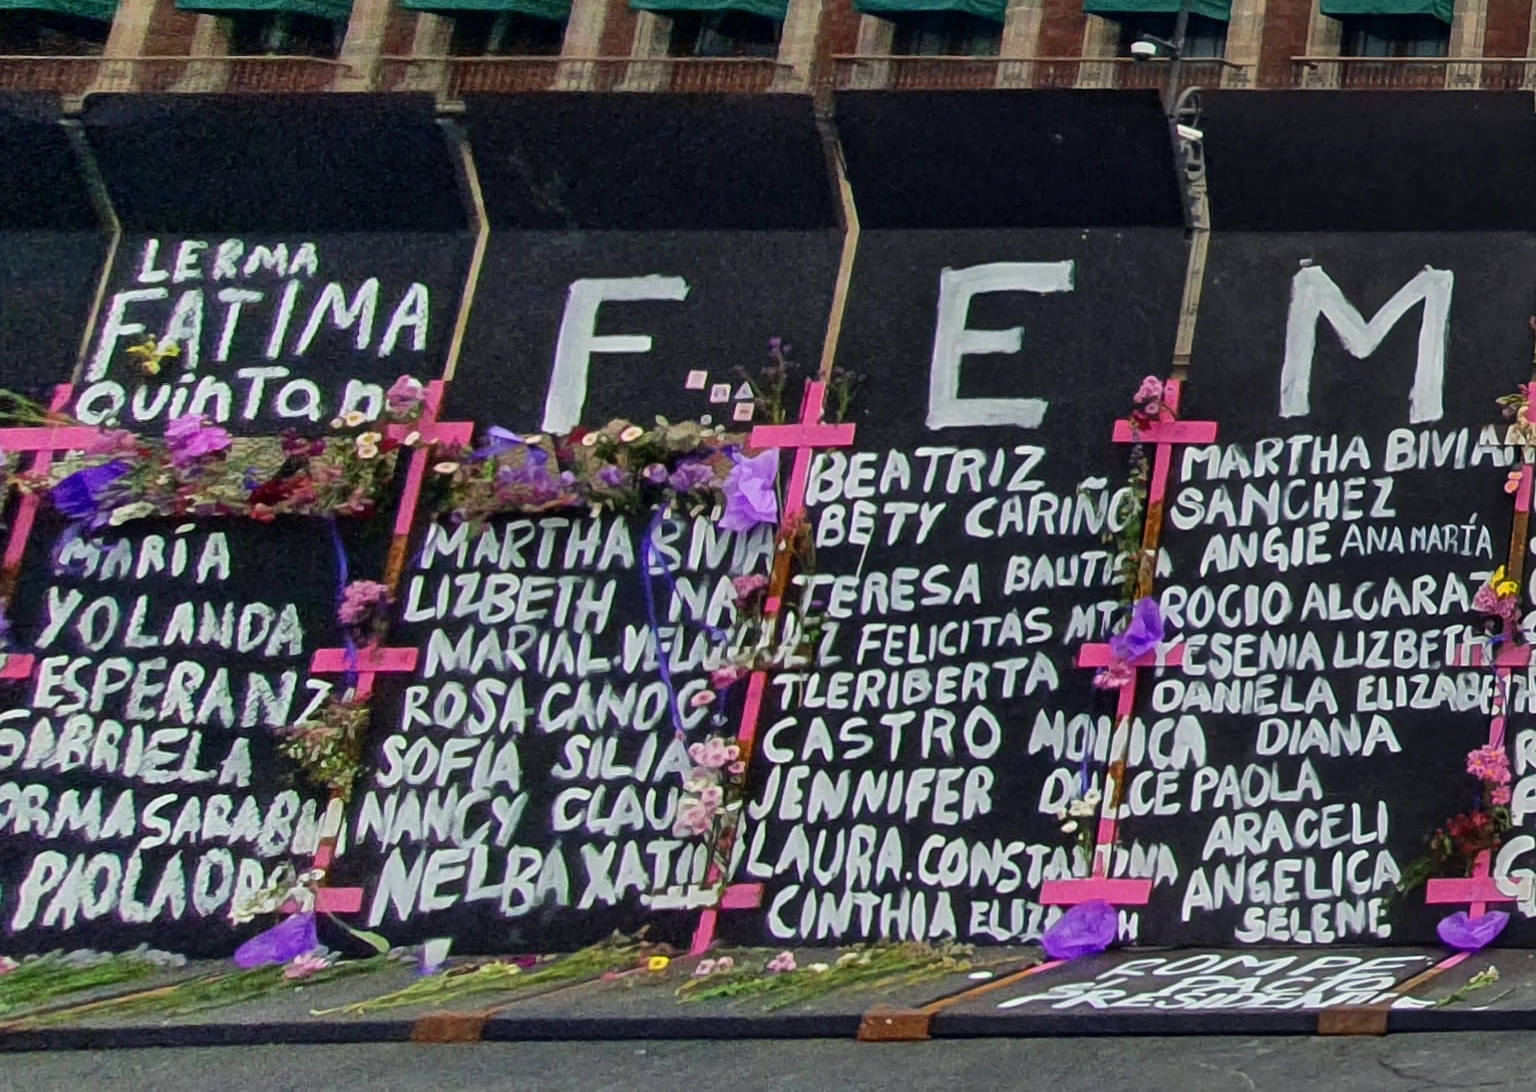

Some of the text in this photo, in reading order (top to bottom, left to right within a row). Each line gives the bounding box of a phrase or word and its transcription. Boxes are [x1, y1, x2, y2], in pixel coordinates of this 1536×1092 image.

[137, 238, 319, 283] LERMA
[84, 277, 429, 383] FATIMA
[806, 445, 1045, 506] BEATRIZ
[1180, 434, 1371, 482] MARTHA
[815, 476, 1141, 548] BETY CARIÑO
[1170, 476, 1397, 531] SANCHEZ
[58, 524, 230, 583] MARÍA
[420, 516, 634, 570] MARTHA
[1200, 512, 1494, 577] ANGIE ANA MARÍA
[404, 573, 617, 634] LIZBETH
[793, 563, 983, 620] TERESA
[1161, 571, 1494, 632] ROCIO ALCARAZ
[34, 586, 304, 658] YOLANDA
[856, 607, 1052, 666] FELICITAS
[1153, 630, 1325, 677] YESENIA
[33, 654, 355, 730] ESPERANZ
[401, 676, 669, 736] ROSA CANO
[1152, 672, 1338, 716] DANIELA
[375, 734, 522, 793] SOFIA
[763, 704, 1206, 770] CASTRO MONICA
[1256, 713, 1402, 758] DIANA
[750, 764, 995, 824] JENNIFER
[1191, 759, 1324, 812] PAOLA
[354, 785, 529, 853] NANCY
[1202, 800, 1390, 861] ARACELI
[368, 843, 571, 927] NELBA
[766, 886, 958, 942] CINTHIA
[1181, 848, 1401, 922] ANGELICA
[1234, 899, 1393, 944] SELENE
